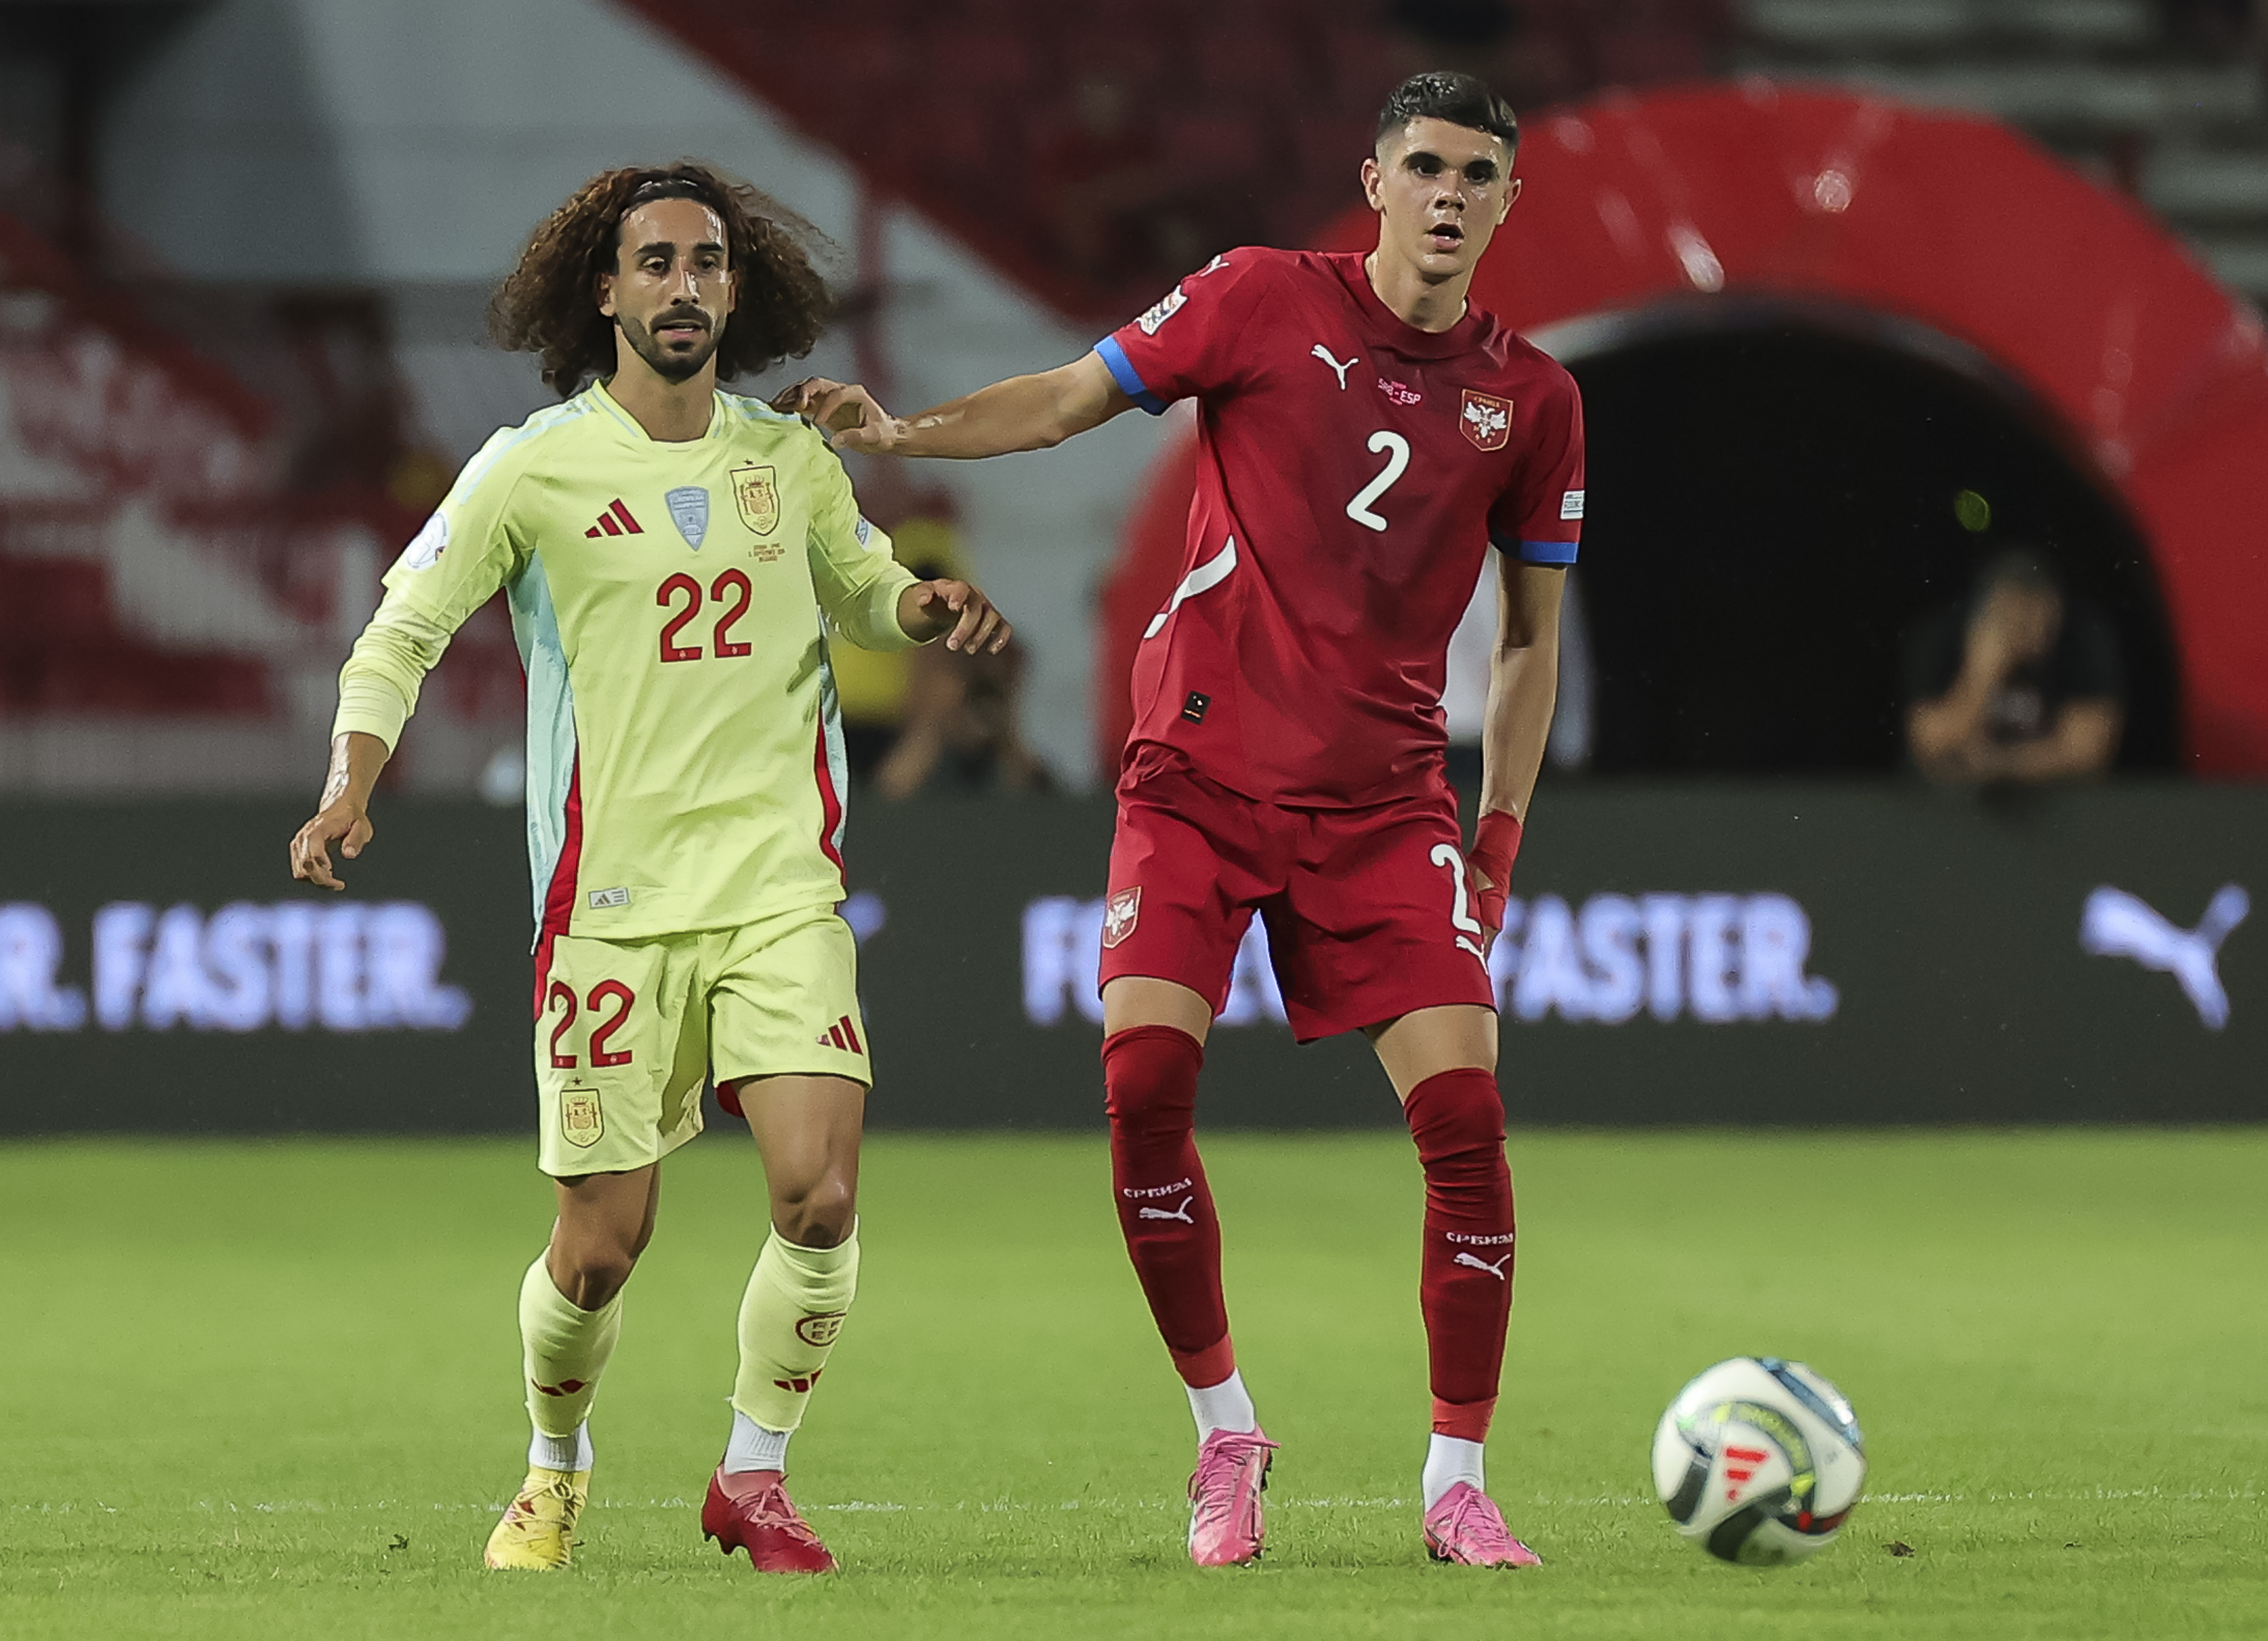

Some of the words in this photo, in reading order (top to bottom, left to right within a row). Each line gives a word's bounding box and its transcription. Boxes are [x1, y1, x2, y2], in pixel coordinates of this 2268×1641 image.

[1346, 430, 1411, 532] 2
[657, 568, 752, 663] 22
[1430, 843, 1482, 935] 2
[93, 902, 470, 1030] FASTER.
[549, 979, 634, 1068] 22
